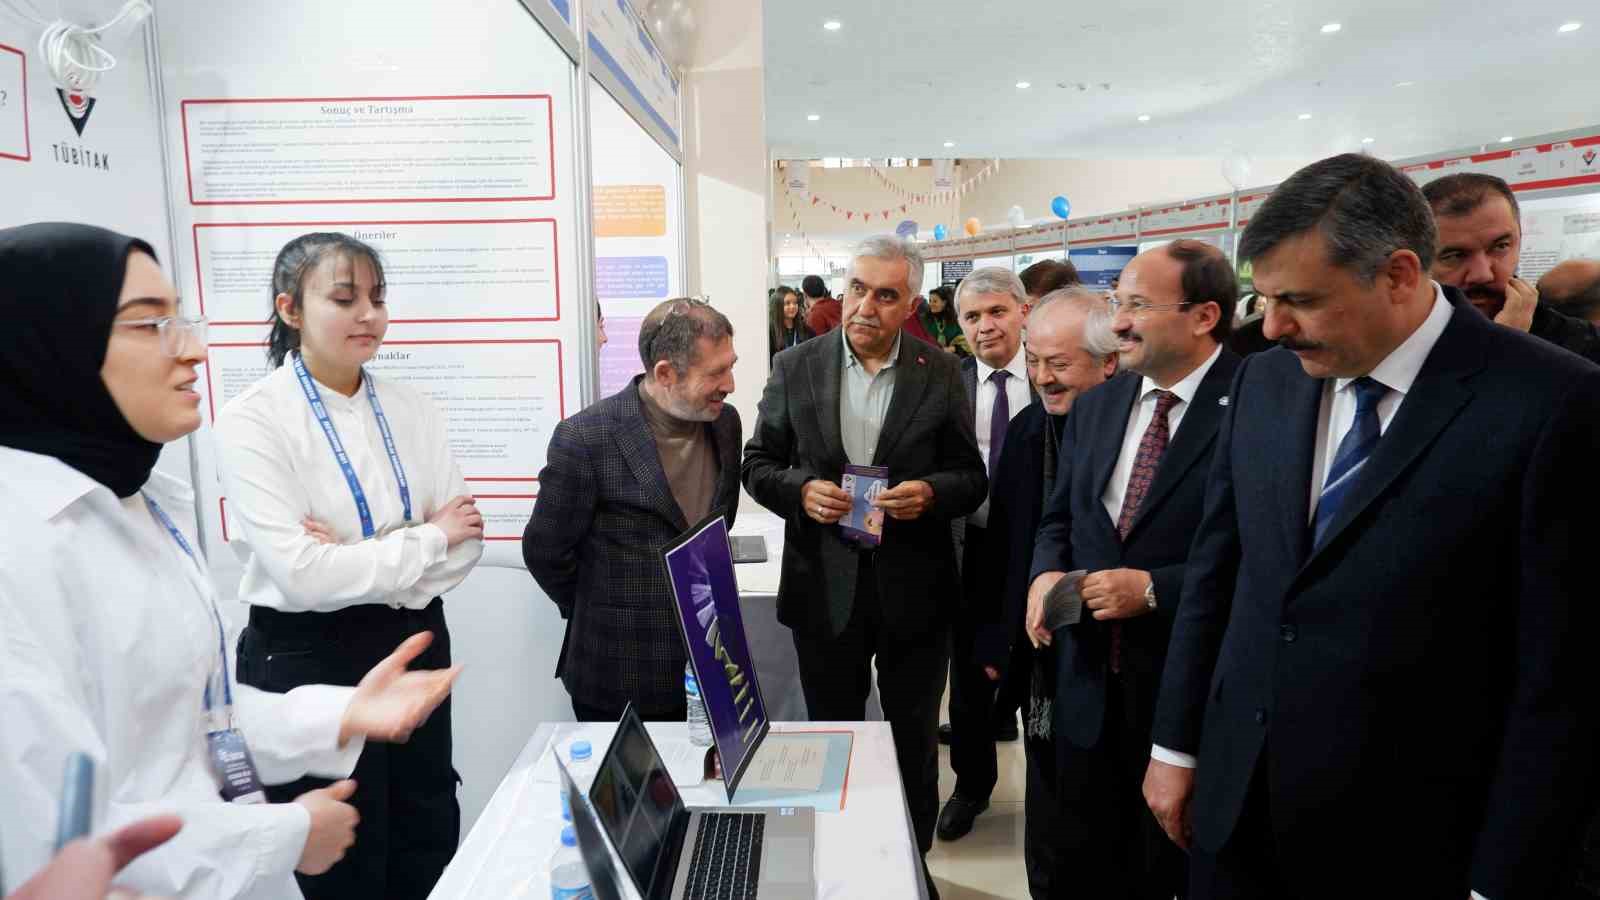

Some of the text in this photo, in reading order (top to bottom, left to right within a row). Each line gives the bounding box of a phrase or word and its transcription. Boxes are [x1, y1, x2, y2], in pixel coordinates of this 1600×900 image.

[320, 105, 351, 116] Sonuç
[367, 104, 414, 115] Tartışma
[52, 142, 110, 171] TÜBİTAK
